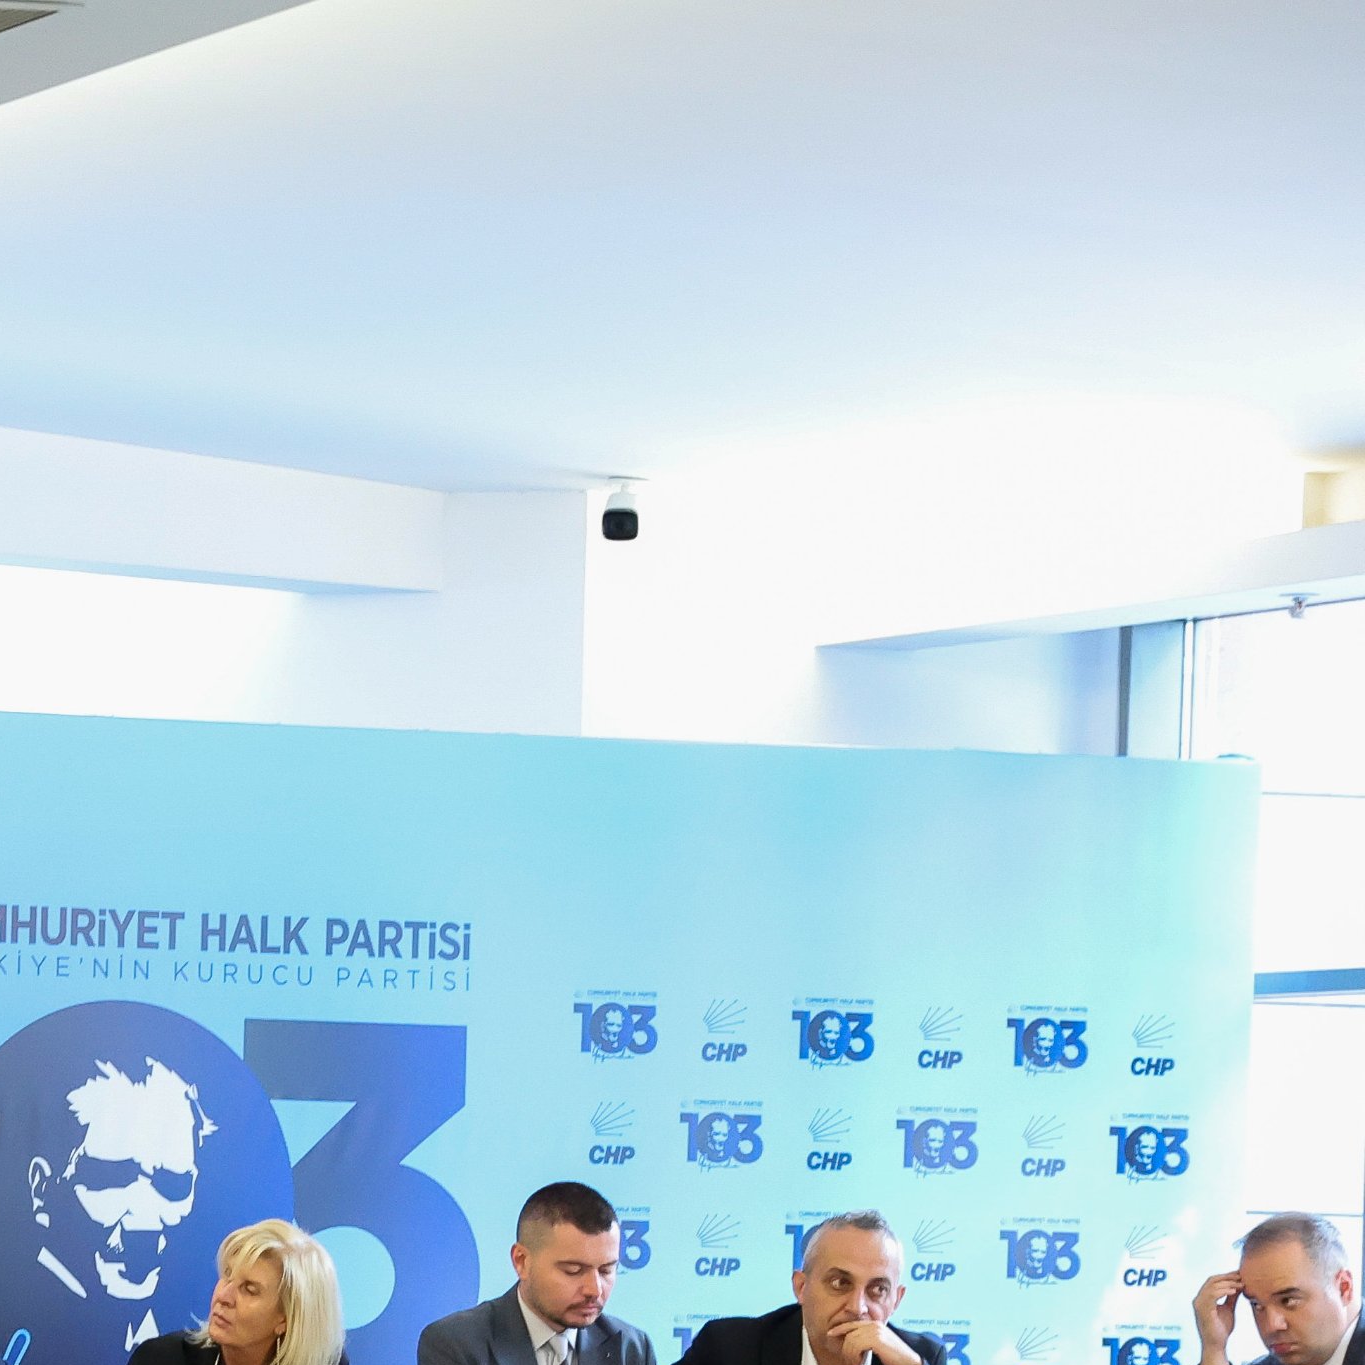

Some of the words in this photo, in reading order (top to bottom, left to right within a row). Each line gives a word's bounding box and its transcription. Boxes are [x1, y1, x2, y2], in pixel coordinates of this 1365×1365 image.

[200, 913, 310, 955] HALK
[174, 960, 313, 986] KURUCU
[336, 965, 470, 991] PARTİSİ
[574, 1002, 658, 1055] 103
[792, 1010, 874, 1062] 103
[702, 1042, 747, 1062] CHP
[1007, 1018, 1088, 1068] 103
[918, 1050, 962, 1068] CHP
[1131, 1057, 1174, 1076] CHP
[680, 1112, 763, 1164] 103
[896, 1119, 978, 1171] 103
[589, 1145, 635, 1164] CHP
[807, 1152, 852, 1170] CHP
[1110, 1126, 1189, 1178] 103
[1021, 1158, 1065, 1177] CHP
[695, 1257, 740, 1276] CHP
[1000, 1230, 1080, 1281] 103
[911, 1263, 955, 1281] CHP
[1124, 1269, 1166, 1286] CHP
